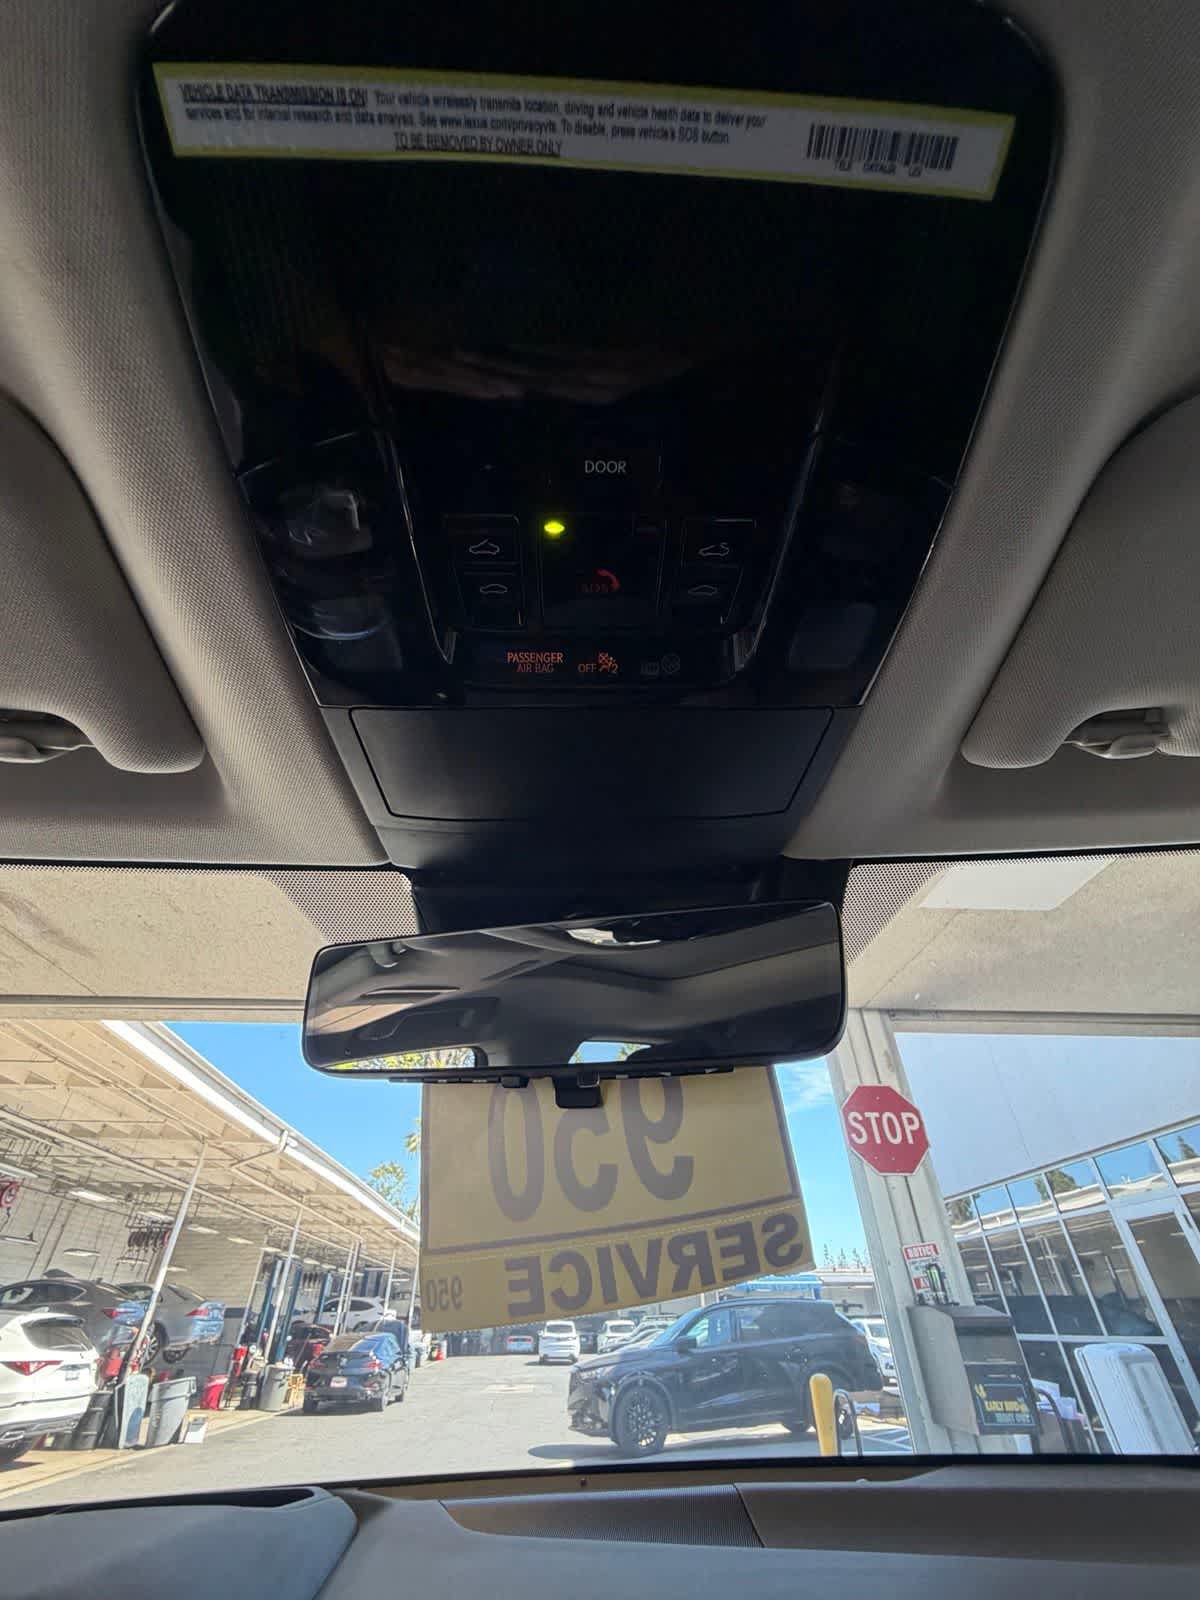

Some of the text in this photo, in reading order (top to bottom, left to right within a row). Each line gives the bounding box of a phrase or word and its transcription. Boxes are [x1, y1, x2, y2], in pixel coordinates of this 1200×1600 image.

[180, 83, 223, 101] VEHICLE
[226, 84, 252, 102] DATA
[375, 90, 396, 105] Your
[564, 100, 594, 118] driving
[597, 102, 616, 117] and
[618, 103, 649, 119] vehicle
[651, 105, 679, 121] health
[680, 107, 700, 122] data
[703, 109, 713, 123] to
[715, 110, 745, 127] deliver
[561, 118, 573, 133] To
[611, 123, 636, 141] press
[393, 131, 563, 157] TO BE REMOVED BY OWNER ONLY
[584, 460, 627, 474] DOOR
[507, 651, 564, 664] PASSENGER
[516, 663, 555, 674] AIR BAG
[577, 662, 597, 674] OFF
[847, 1111, 921, 1146] STOP
